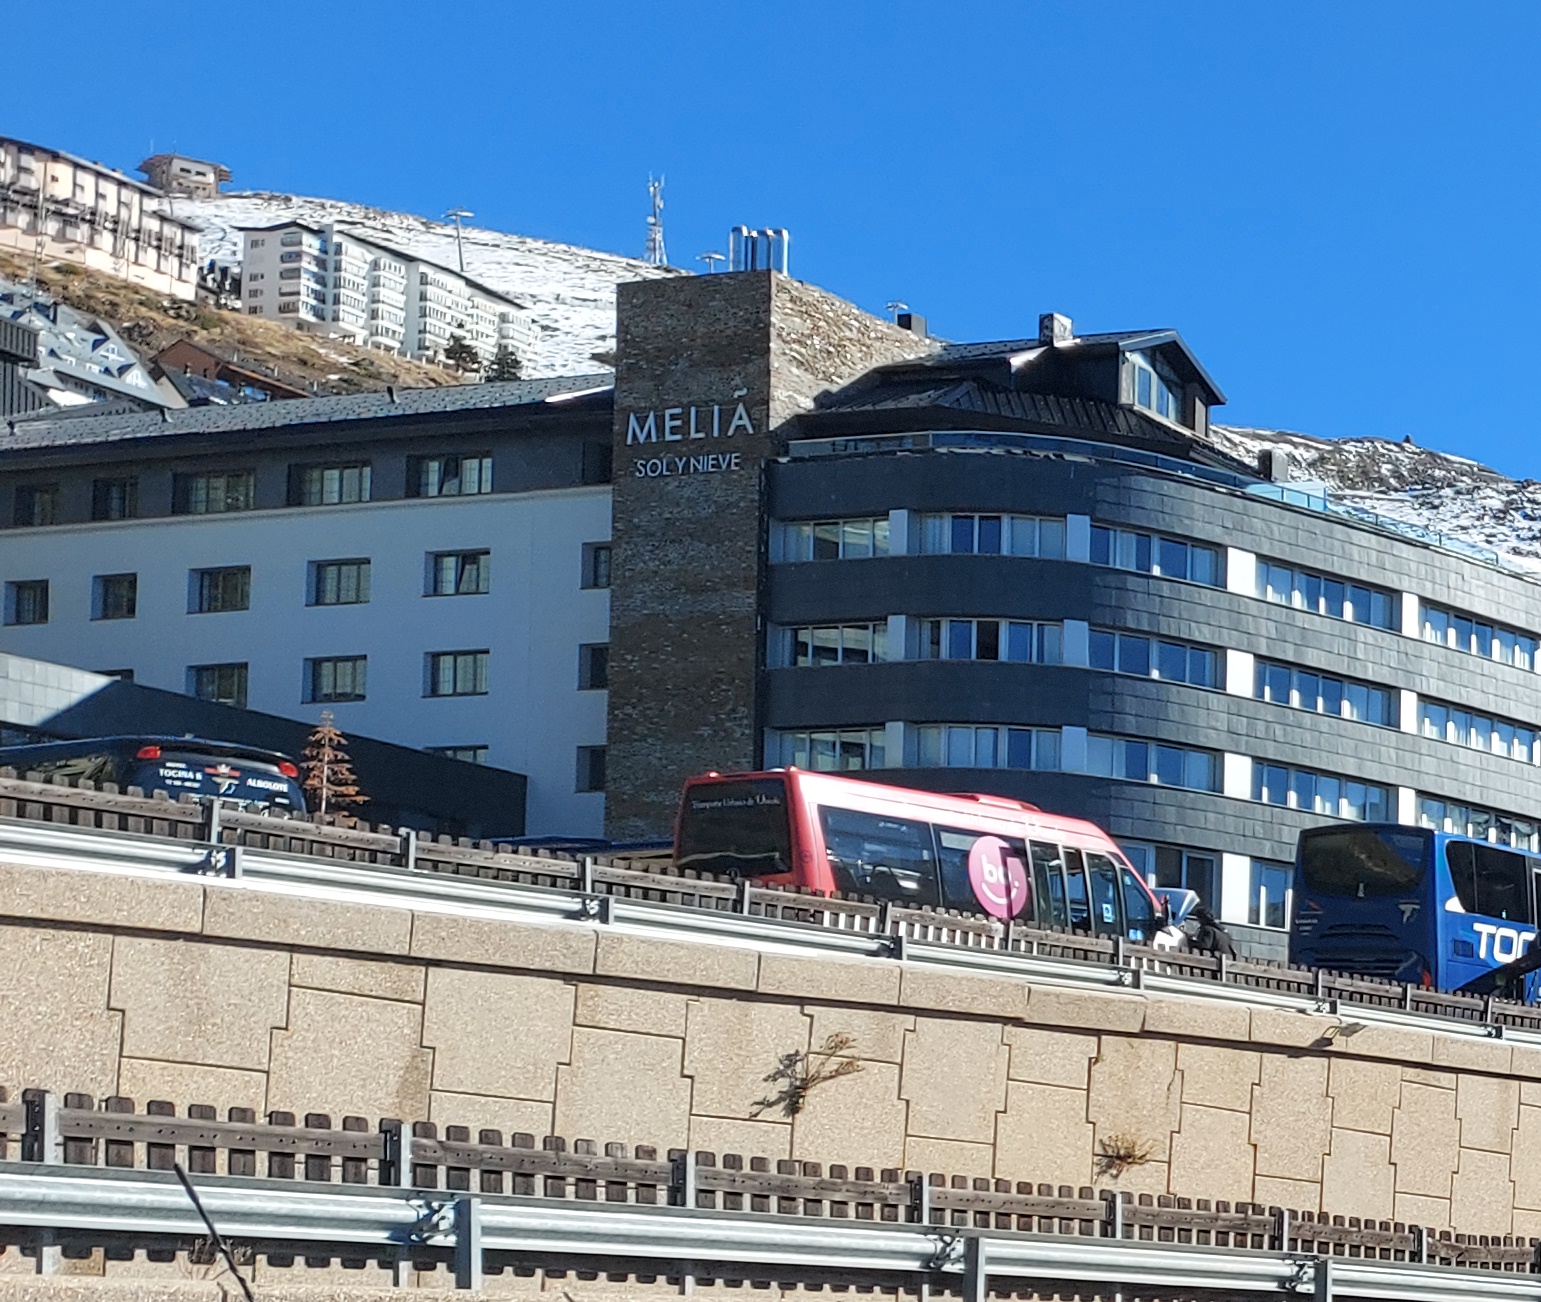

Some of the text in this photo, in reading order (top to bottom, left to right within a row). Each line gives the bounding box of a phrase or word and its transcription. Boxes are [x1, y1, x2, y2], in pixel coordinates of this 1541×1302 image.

[635, 452, 741, 477] SOL Y NIEVE
